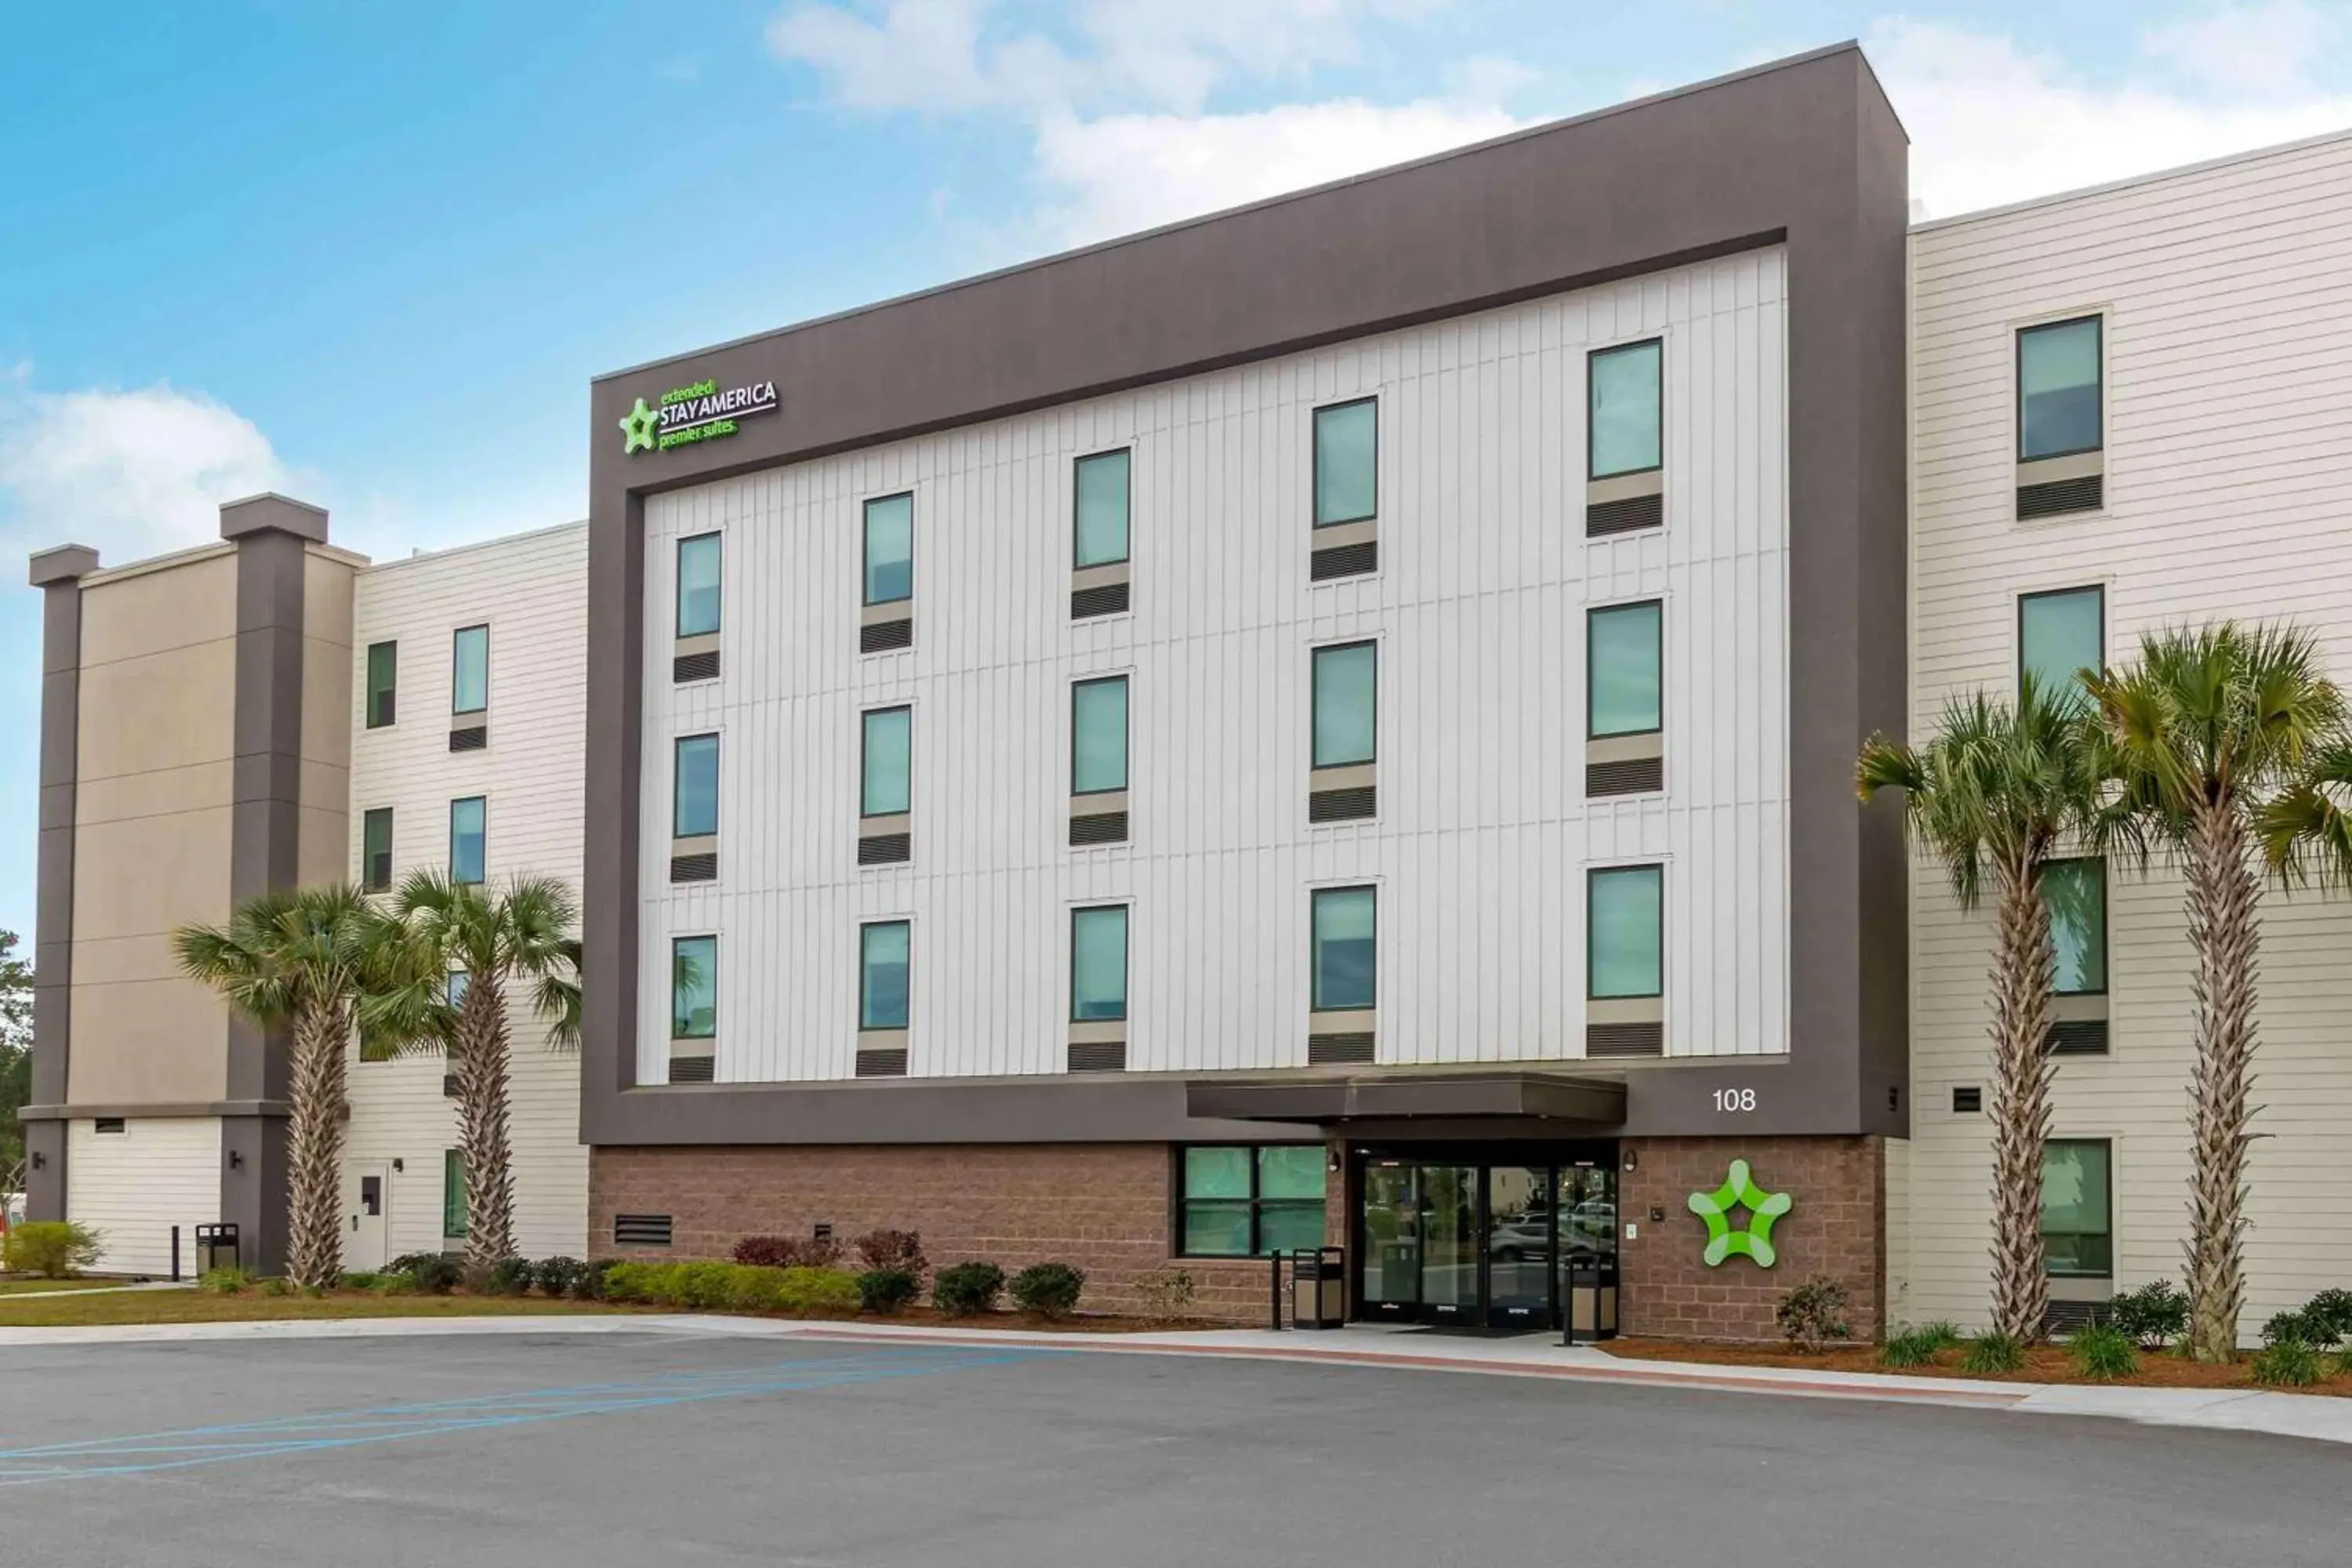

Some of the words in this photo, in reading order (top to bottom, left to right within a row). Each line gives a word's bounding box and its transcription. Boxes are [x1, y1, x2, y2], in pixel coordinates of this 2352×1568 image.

[661, 378, 715, 405] extended
[659, 426, 702, 451] premier
[1712, 1088, 1756, 1111] 108
